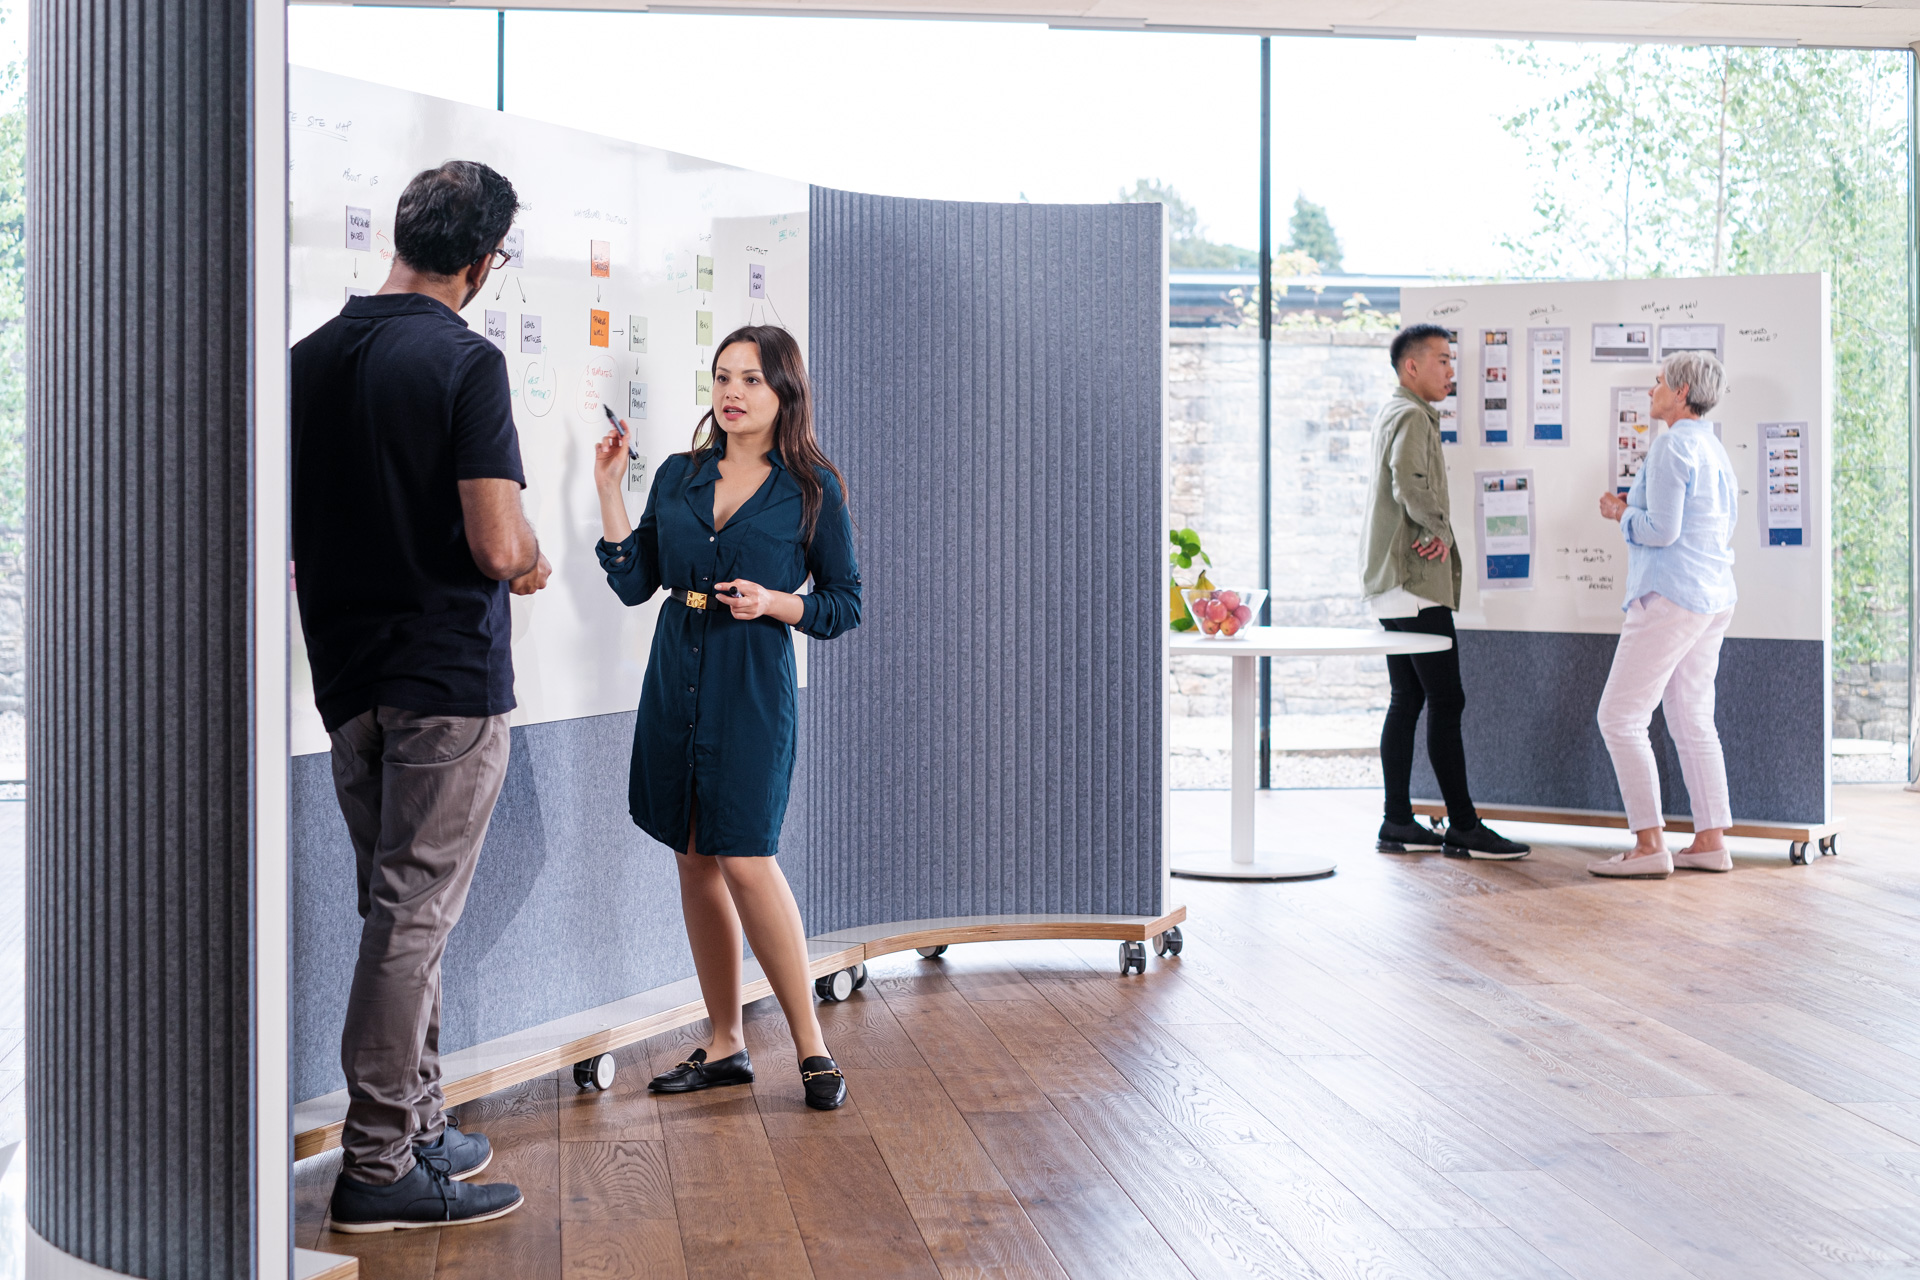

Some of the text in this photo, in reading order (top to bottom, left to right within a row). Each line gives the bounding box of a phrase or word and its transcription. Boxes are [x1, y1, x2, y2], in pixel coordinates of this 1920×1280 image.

[307, 115, 326, 127] SITE
[342, 167, 379, 187] ABOUT US
[745, 245, 768, 256] CONTACT
